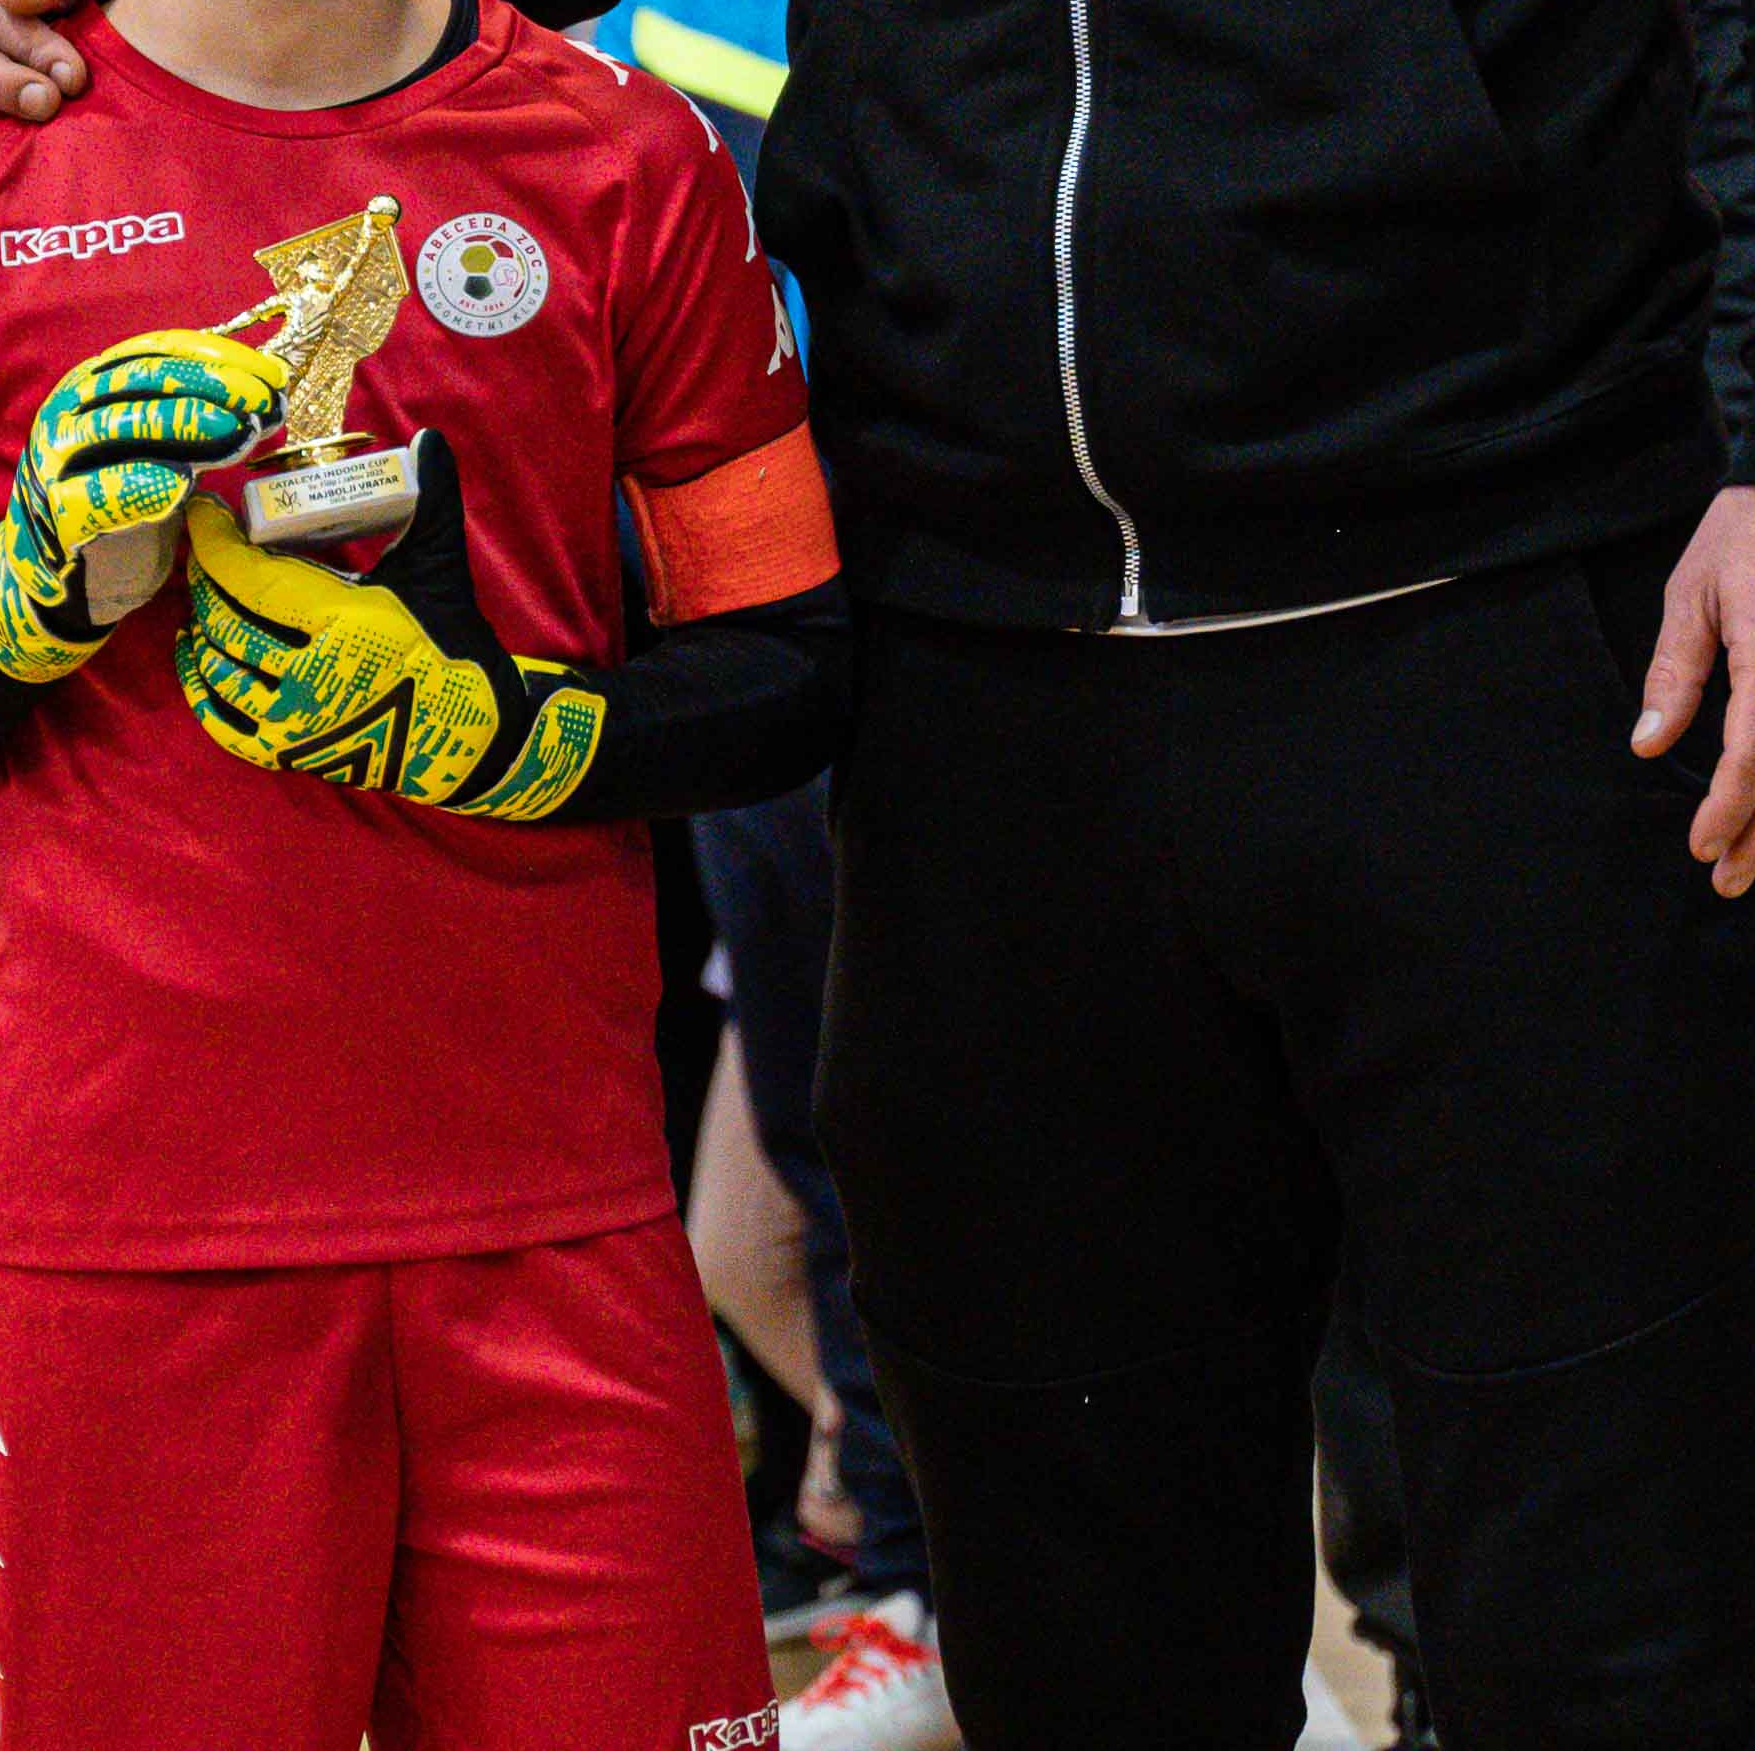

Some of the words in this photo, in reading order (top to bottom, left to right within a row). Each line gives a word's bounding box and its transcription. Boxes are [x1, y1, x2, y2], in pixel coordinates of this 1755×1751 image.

[0, 211, 185, 267] Kappa
[425, 217, 508, 262] ABECEDA
[516, 233, 542, 267] ZDC
[513, 288, 541, 322] KLUB
[269, 473, 321, 490] CATALEYA
[324, 463, 366, 479] INDOOR
[367, 458, 390, 469] CUP
[308, 484, 357, 500] NAJBOLJI
[358, 474, 399, 489] VRATAR
